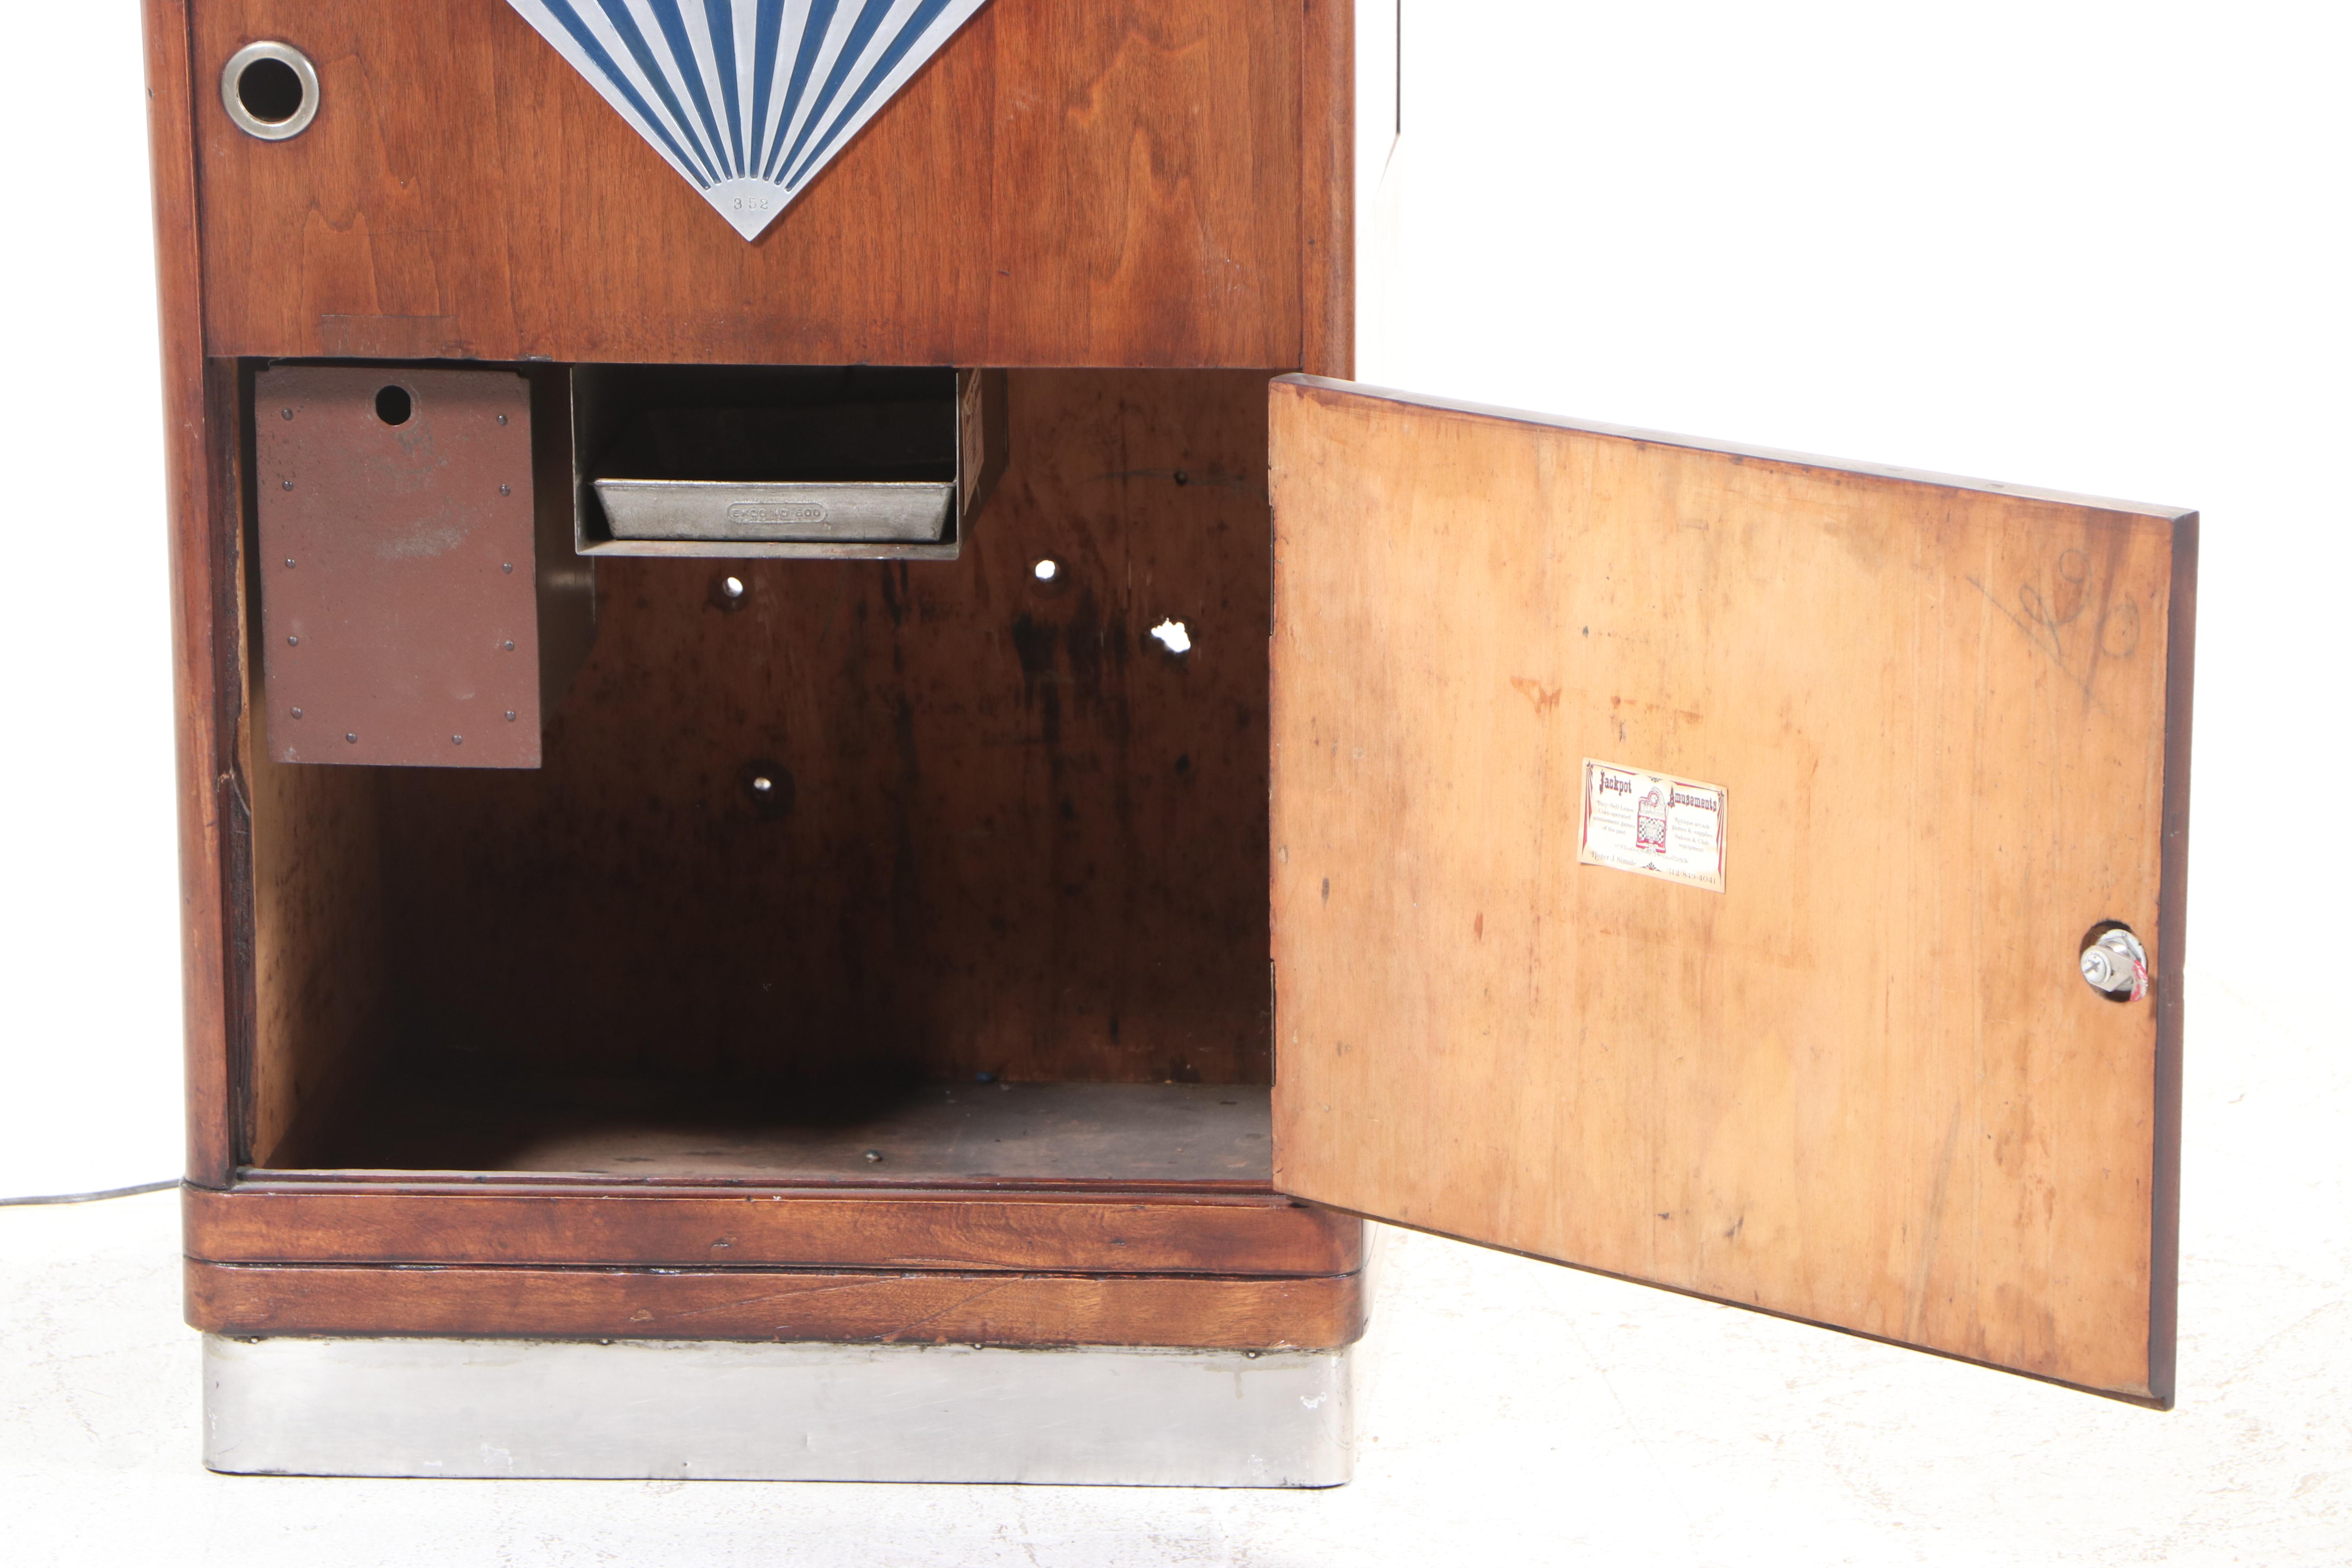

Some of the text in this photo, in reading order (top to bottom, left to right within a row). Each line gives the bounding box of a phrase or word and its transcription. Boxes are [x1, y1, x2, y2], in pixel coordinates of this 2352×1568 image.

[733, 198, 768, 210] 352
[795, 508, 821, 517] 600
[1599, 769, 1717, 812] Jackpot Amusements
[1611, 811, 1631, 820] operated
[1593, 817, 1619, 826] amusement
[1674, 817, 1693, 826] Antique
[1675, 833, 1691, 842] Saloon
[1679, 843, 1704, 852] equipment
[1589, 850, 1610, 861] Roger
